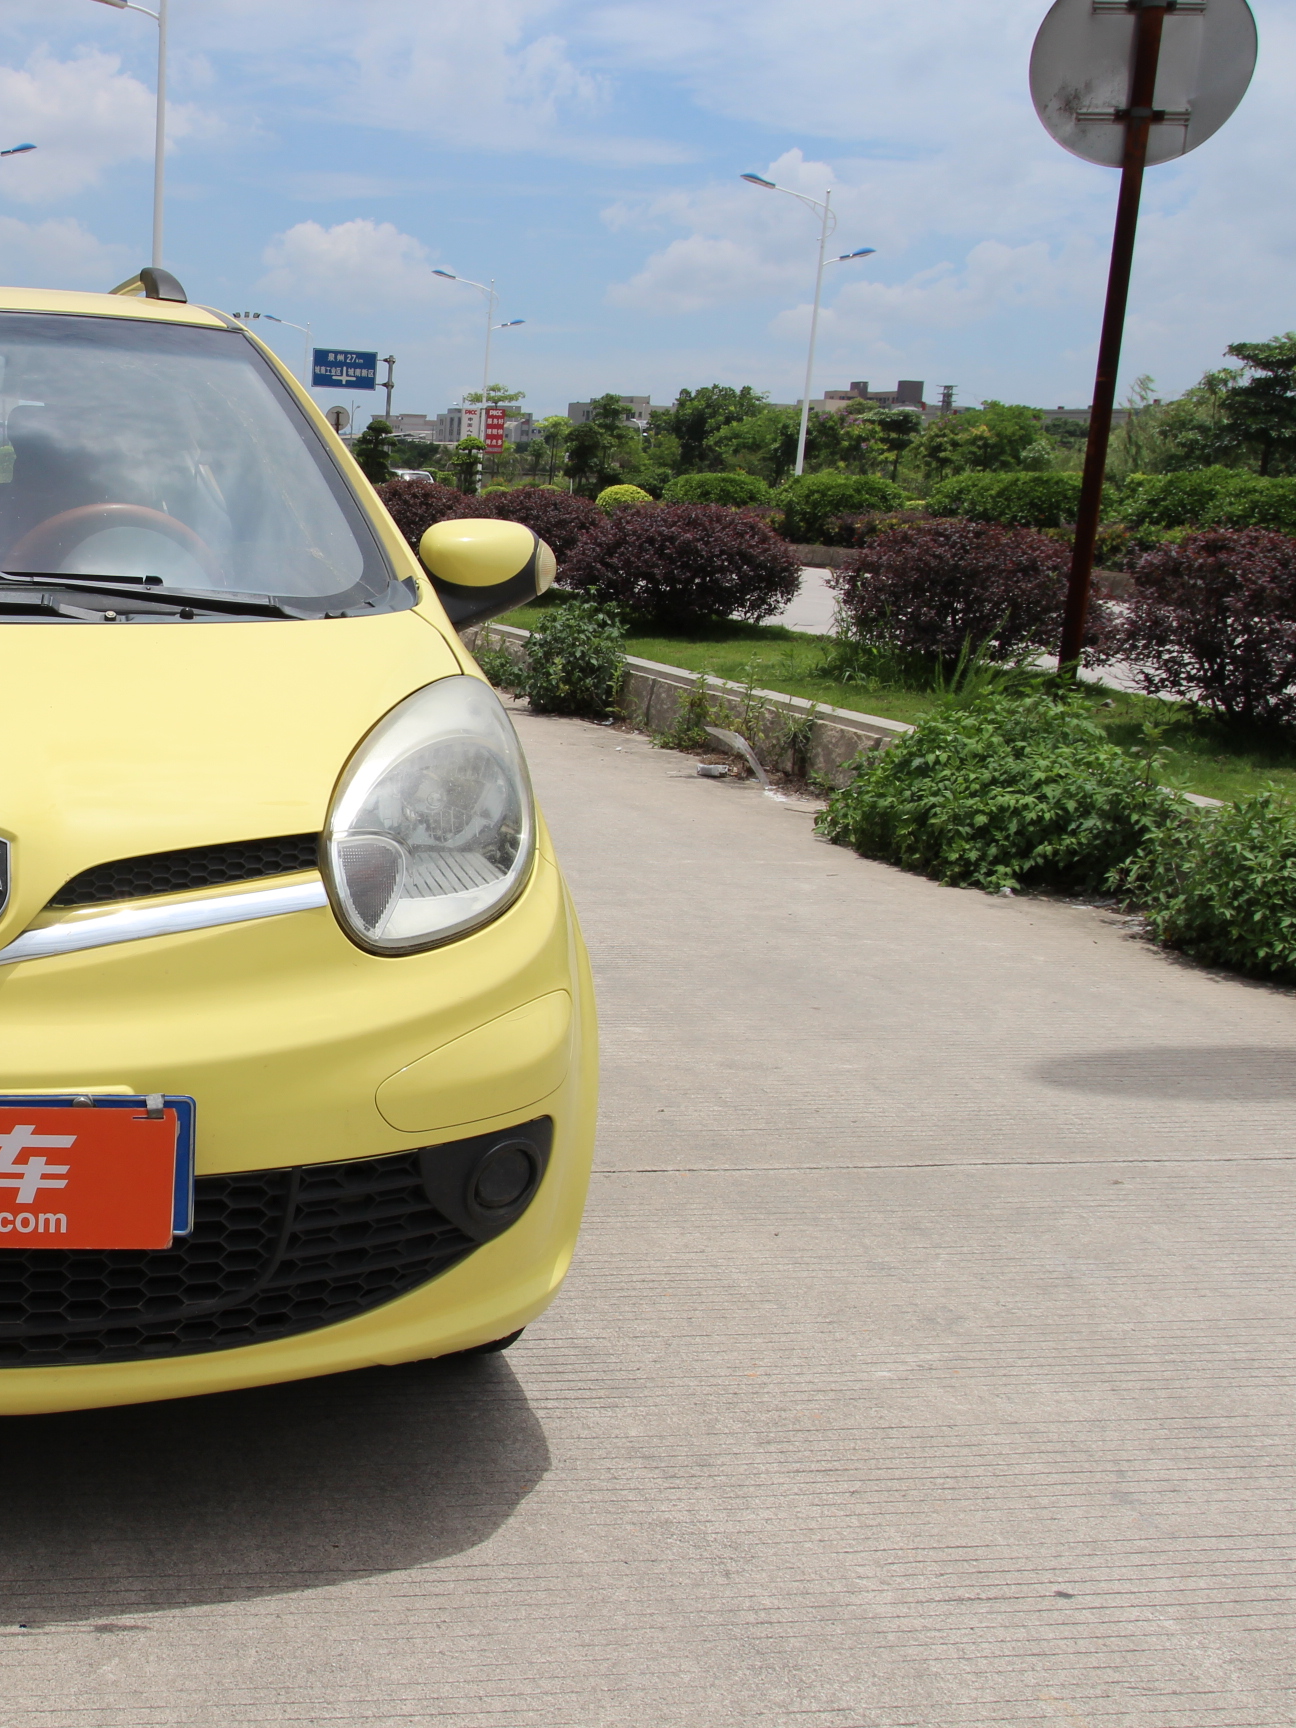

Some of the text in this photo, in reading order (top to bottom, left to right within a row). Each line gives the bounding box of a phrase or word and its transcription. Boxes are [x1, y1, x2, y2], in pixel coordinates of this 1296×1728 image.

[327, 353, 345, 362] 泉州
[347, 367, 375, 378] 城南新区
